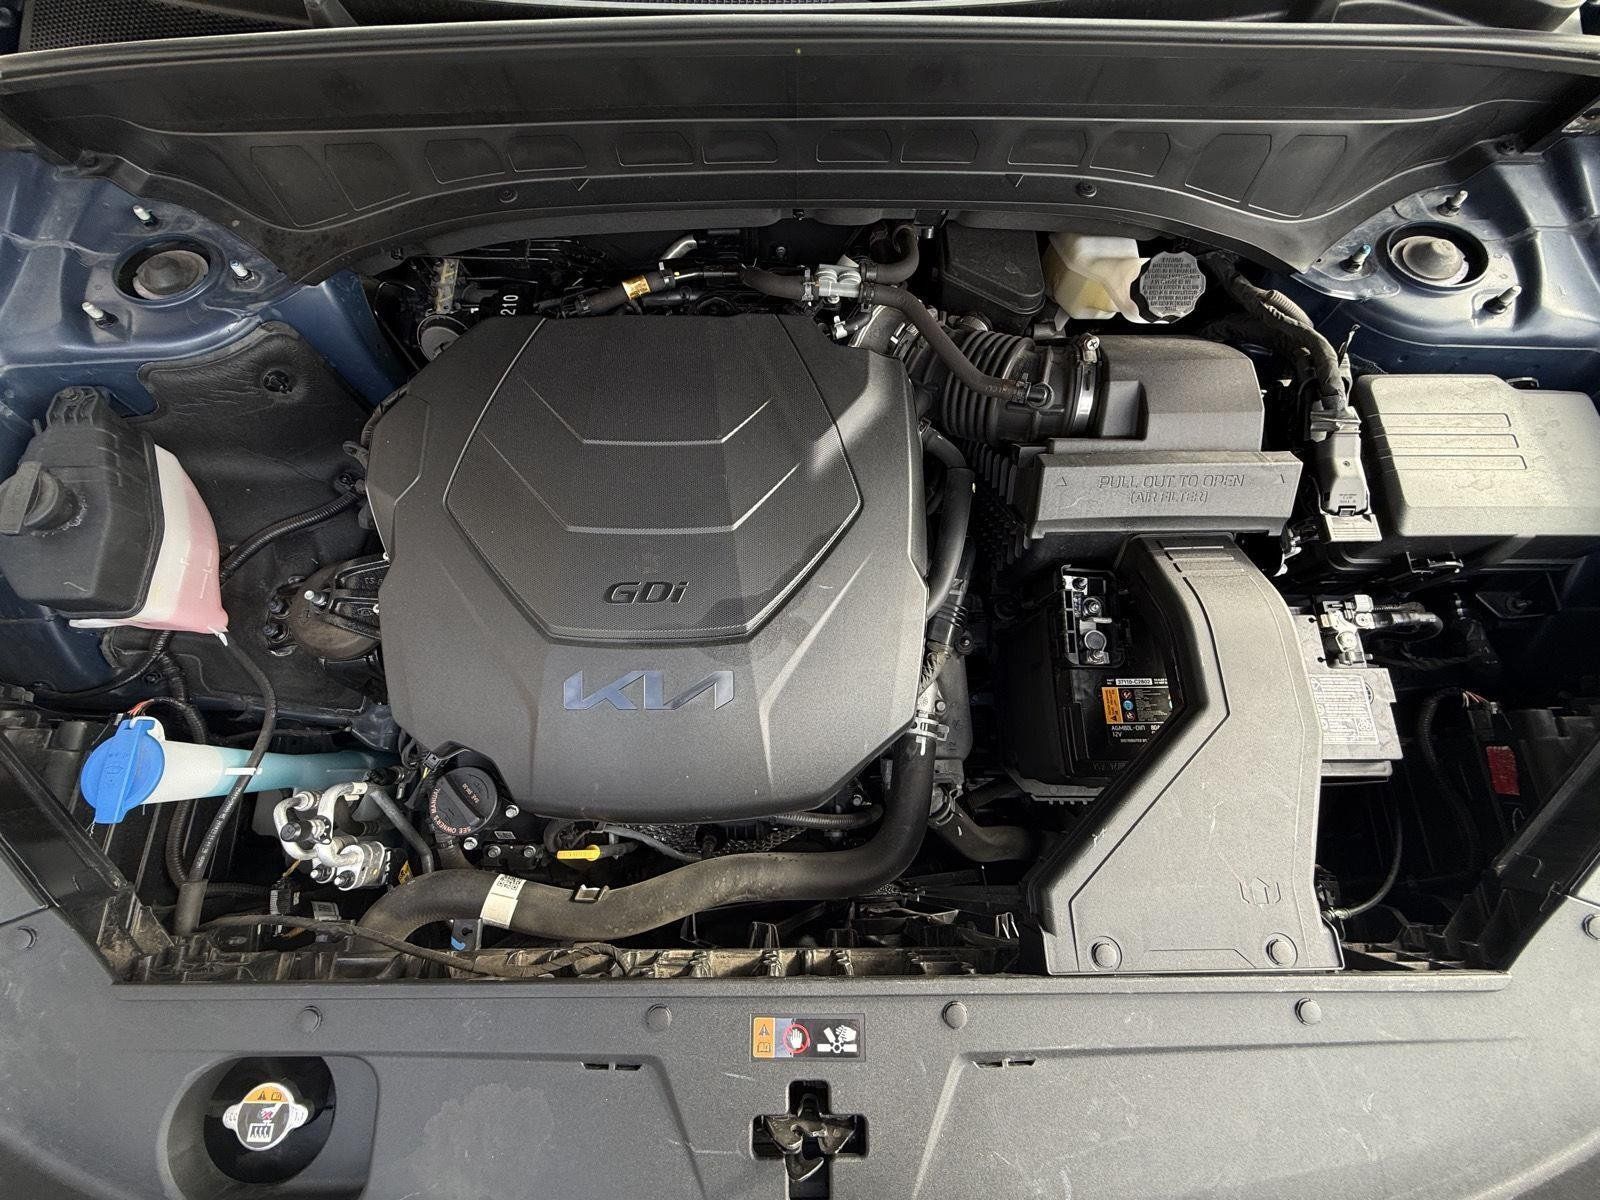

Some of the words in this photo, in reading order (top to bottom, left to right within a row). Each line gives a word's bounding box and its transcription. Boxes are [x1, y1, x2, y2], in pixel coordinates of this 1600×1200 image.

[500, 294, 519, 316] 210
[1098, 475, 1138, 489] PULL
[1143, 474, 1175, 488] OUT
[1180, 474, 1199, 487] TO
[1202, 474, 1245, 487] OPEN
[1130, 491, 1157, 504] (AIR
[1160, 490, 1208, 503] FILTER)
[603, 581, 689, 604] GDi
[563, 670, 734, 710] KIA
[430, 787, 441, 814] MANUAL
[458, 825, 472, 834] SEE
